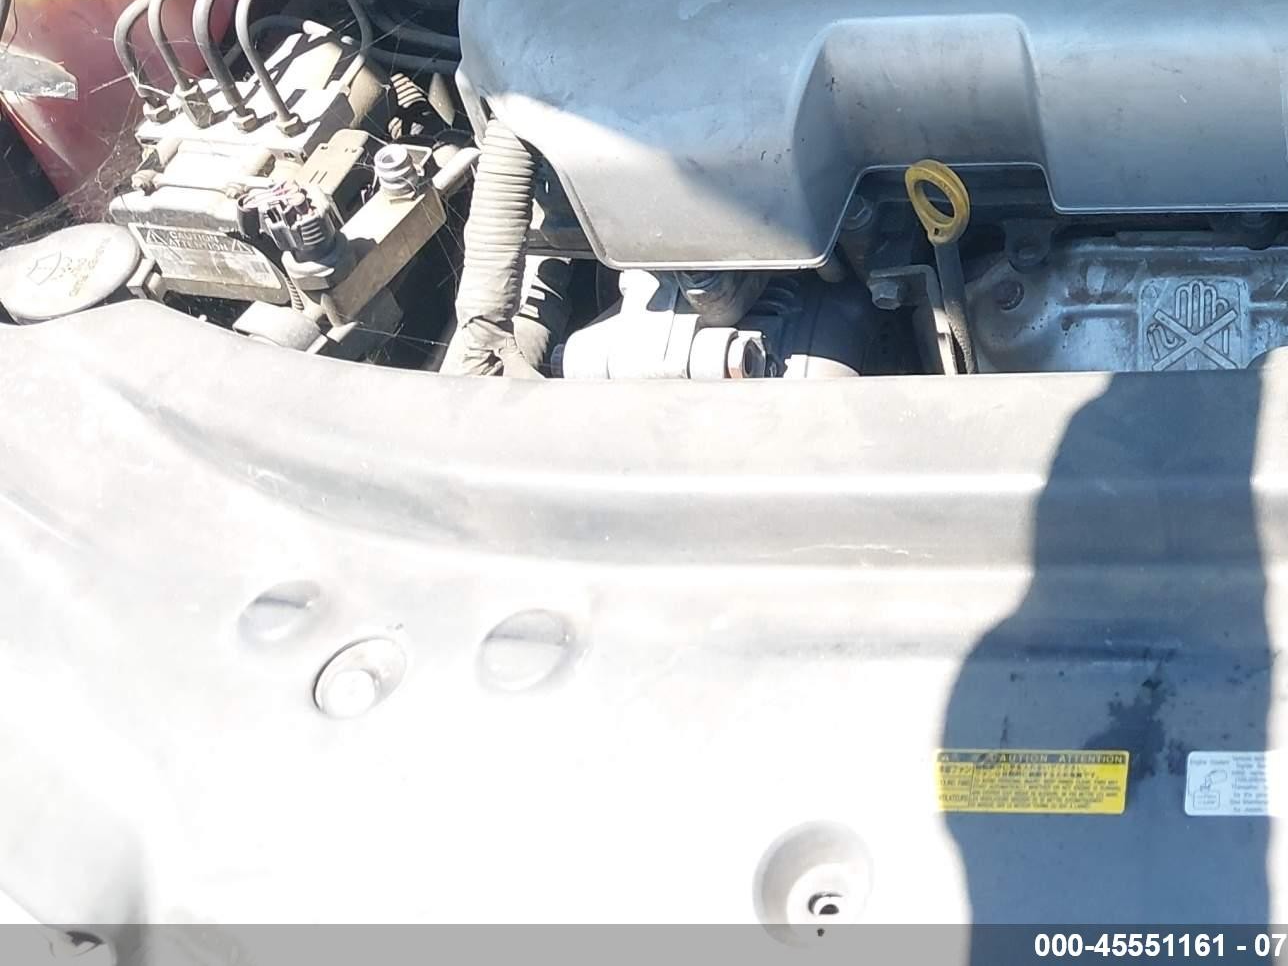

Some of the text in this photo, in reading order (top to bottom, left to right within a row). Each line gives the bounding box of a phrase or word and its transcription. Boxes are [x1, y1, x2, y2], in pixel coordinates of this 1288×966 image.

[169, 231, 219, 244] CAUTION
[169, 238, 229, 252] ATTENTION
[1058, 753, 1124, 764] ATTENTION
